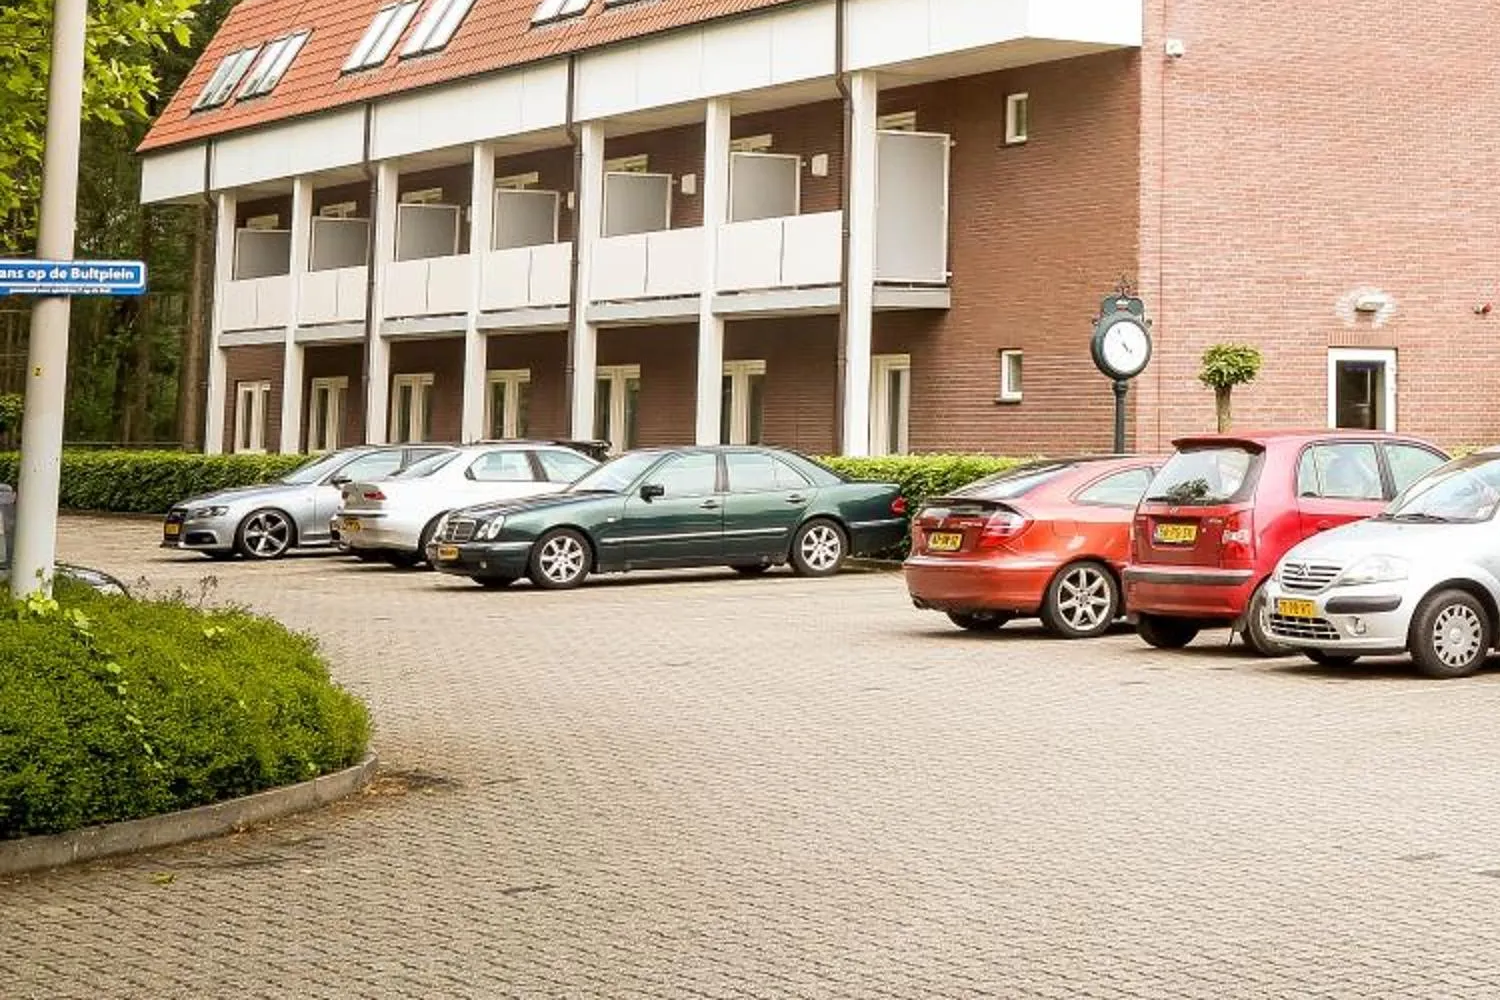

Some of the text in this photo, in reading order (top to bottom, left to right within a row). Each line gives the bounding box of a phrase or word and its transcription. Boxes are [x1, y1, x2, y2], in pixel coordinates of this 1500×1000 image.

[27, 269, 46, 281] op
[49, 266, 68, 279] de
[71, 267, 135, 282] Bultplein
